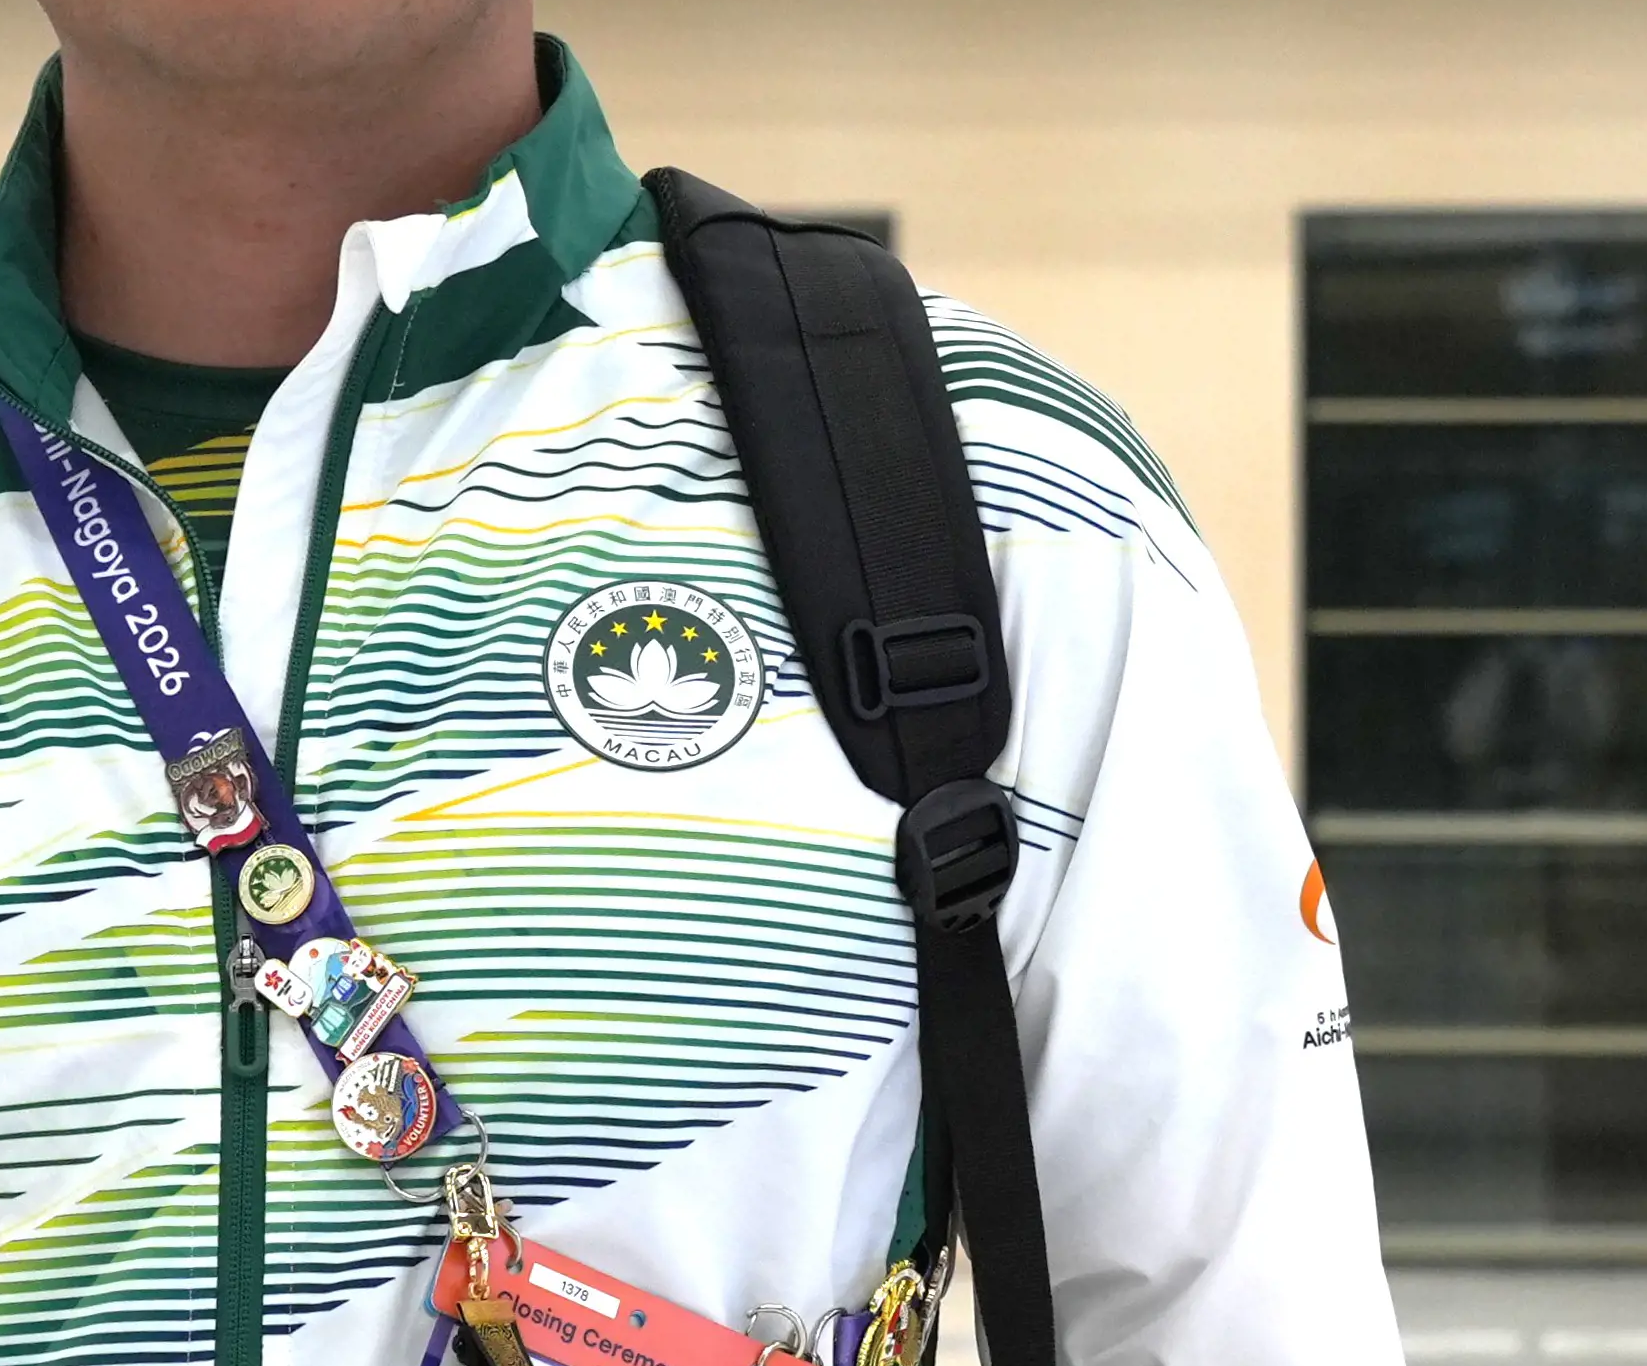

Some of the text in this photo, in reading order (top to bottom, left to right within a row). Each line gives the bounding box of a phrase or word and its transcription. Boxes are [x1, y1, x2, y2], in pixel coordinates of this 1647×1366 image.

[124, 604, 191, 696] 2026
[553, 586, 756, 709] 中華人民共和國澳門特別行政區
[603, 738, 702, 763] MACAU
[351, 984, 406, 1057] HONG KONG CHINA
[352, 988, 394, 1043] AICHI-NAGOYA
[404, 1084, 428, 1146] VOLUNTEER
[561, 1280, 589, 1302] 1378
